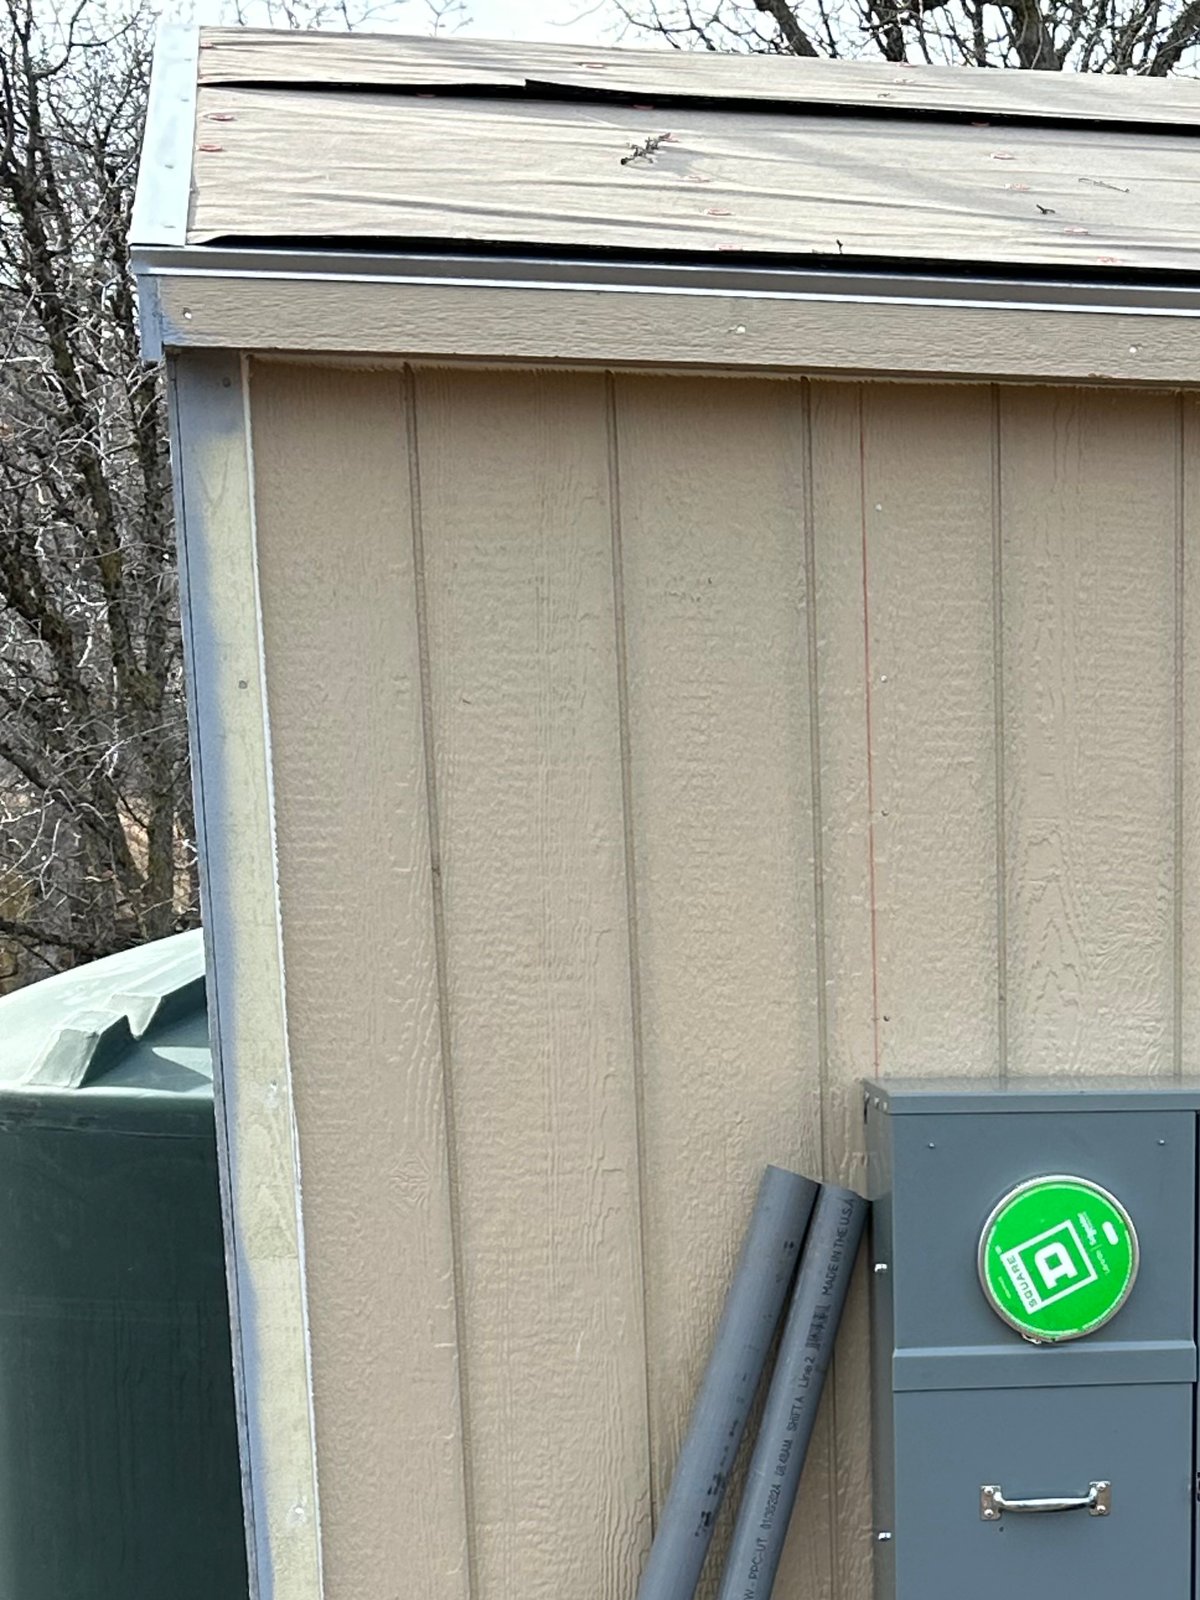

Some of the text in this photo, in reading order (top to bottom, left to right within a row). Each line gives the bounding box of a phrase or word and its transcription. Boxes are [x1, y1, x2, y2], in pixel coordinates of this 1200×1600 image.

[833, 1228, 848, 1248] THE
[829, 1249, 842, 1262] IN
[1034, 1241, 1078, 1290] D
[821, 1263, 839, 1296] MADE
[1006, 1255, 1038, 1308] SQUARE
[804, 1354, 815, 1364] 2
[797, 1363, 813, 1389] Line
[793, 1394, 805, 1404] A
